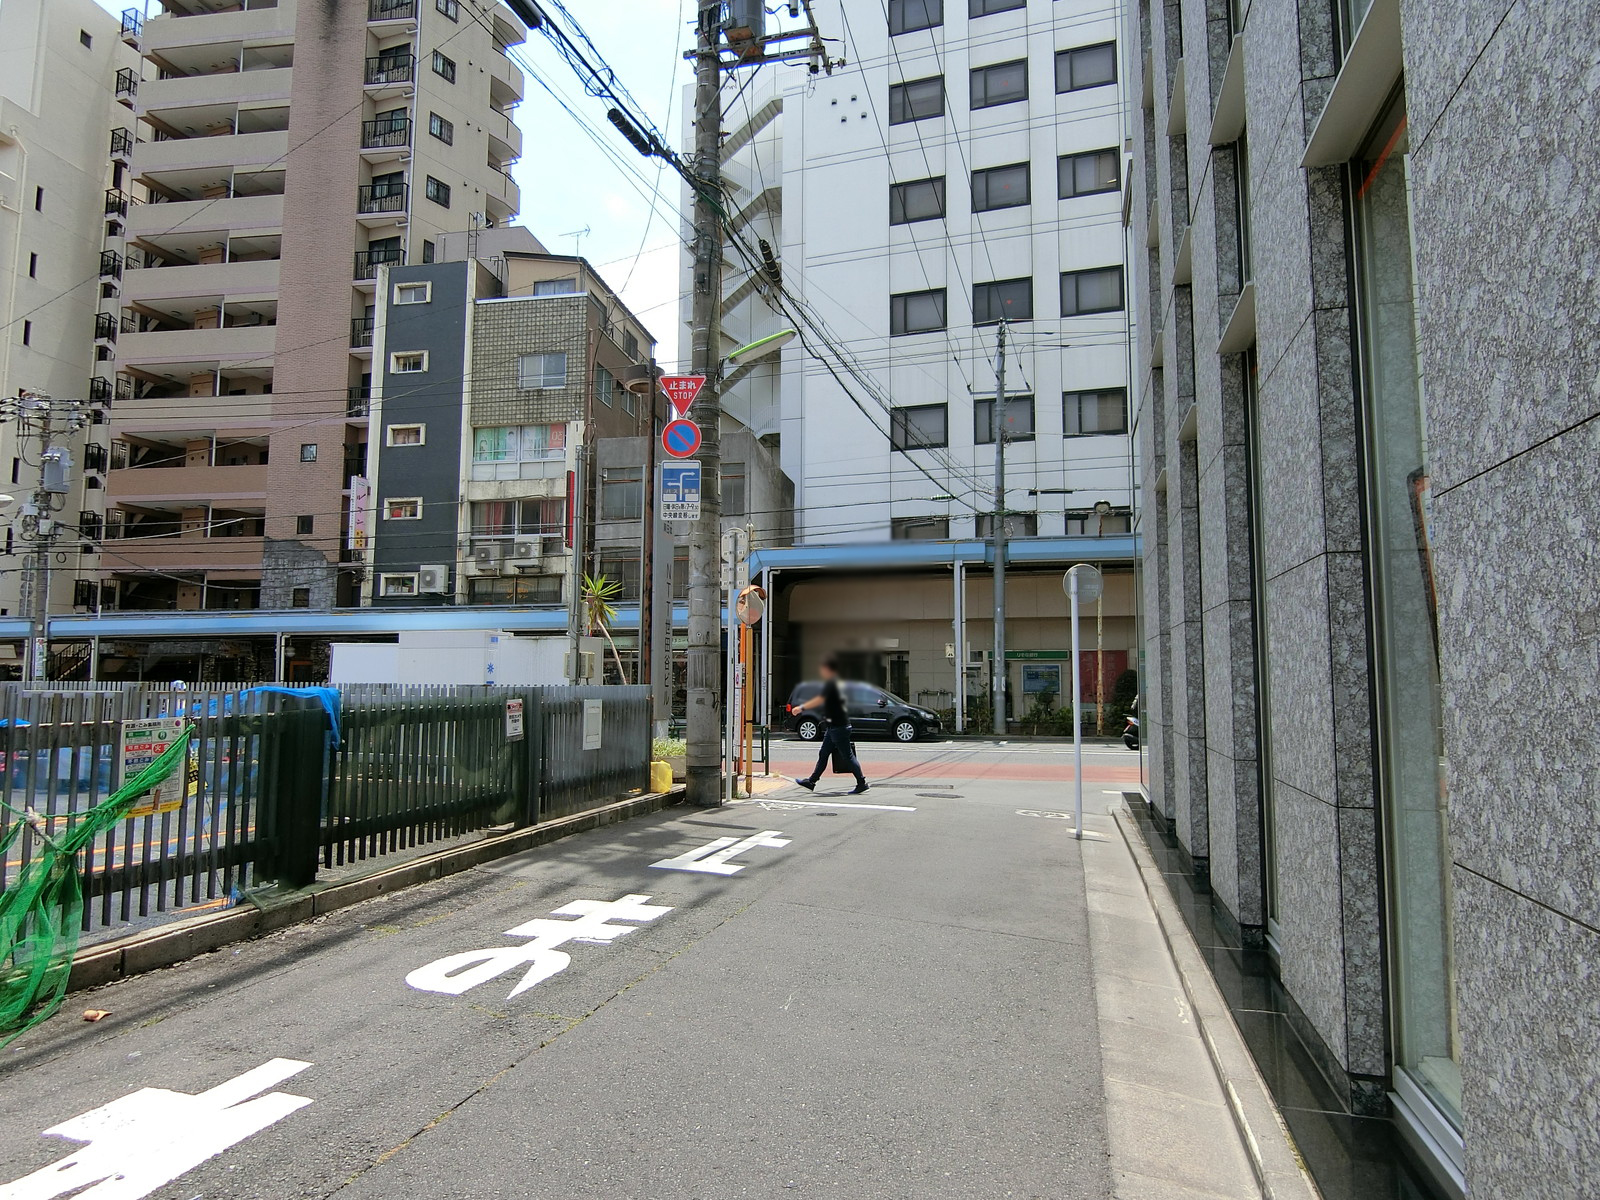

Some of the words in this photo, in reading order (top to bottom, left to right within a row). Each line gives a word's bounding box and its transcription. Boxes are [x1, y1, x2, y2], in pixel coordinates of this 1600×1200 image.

[669, 381, 697, 390] 止まれ
[673, 392, 693, 400] STOP
